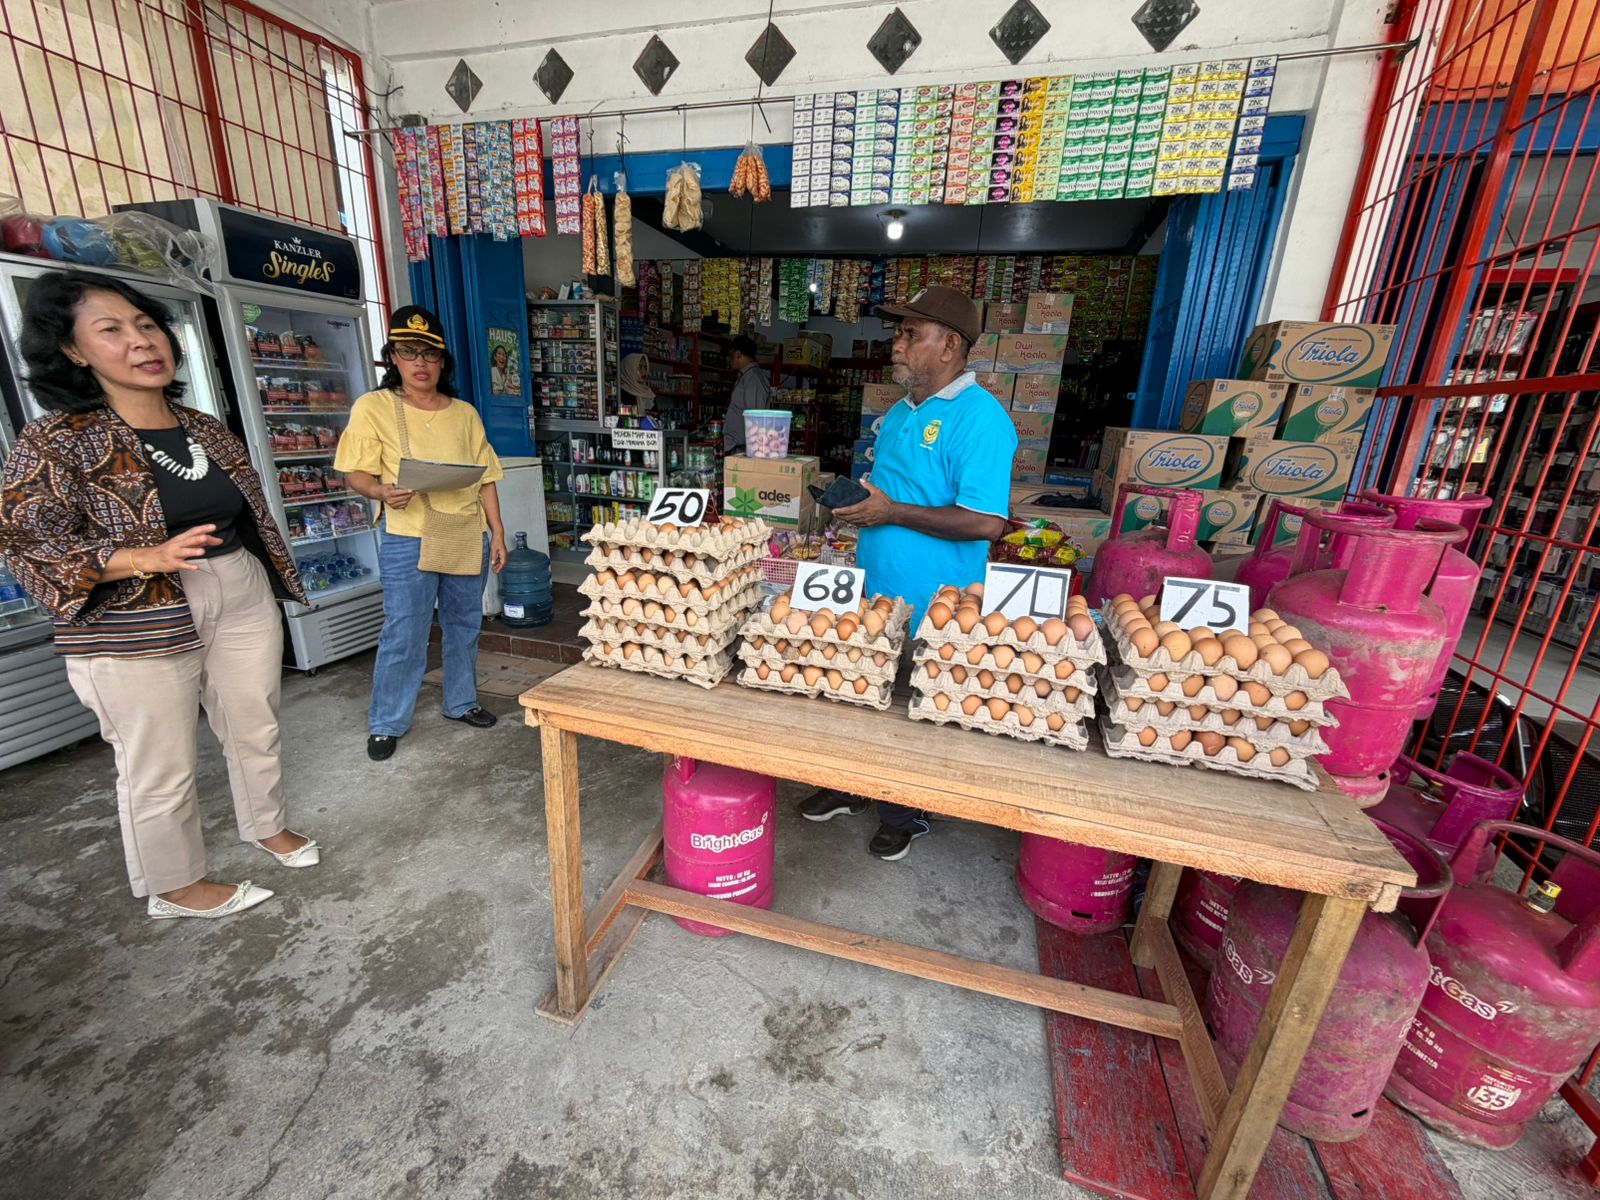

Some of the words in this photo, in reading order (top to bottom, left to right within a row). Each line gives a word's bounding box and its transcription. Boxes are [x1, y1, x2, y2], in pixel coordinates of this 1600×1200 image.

[1227, 62, 1242, 70] ZINC
[1255, 57, 1272, 66] ZINC
[1121, 68, 1142, 76] PANTENE
[1177, 66, 1193, 75] ZINC
[1205, 63, 1220, 72] ZINC
[1201, 82, 1216, 91] ZINC
[1222, 82, 1238, 90] ZINC
[1251, 78, 1268, 87] ZINC
[1118, 87, 1139, 95] PANTENE
[1174, 86, 1190, 94] ZINC
[1197, 102, 1212, 110] ZINC
[1218, 102, 1234, 110] ZINC
[1248, 98, 1264, 106] ZINC
[1115, 106, 1136, 114] PANTENE
[1142, 104, 1163, 112] PANTENE
[1171, 105, 1187, 113] ZINC
[1138, 122, 1160, 130] PANTENE
[1193, 122, 1208, 131] ZINC
[1214, 122, 1230, 130] ZINC
[1245, 118, 1260, 126] ZINC
[1168, 125, 1183, 133] ZINC
[1164, 144, 1180, 152] ZINC
[1189, 141, 1204, 149] ZINC
[1209, 141, 1224, 149] ZINC
[1161, 162, 1176, 170] ZINC
[1186, 160, 1200, 168] ZINC
[1205, 160, 1221, 168] ZINC
[1182, 179, 1197, 187] ZINC
[1202, 178, 1217, 186] ZINC
[273, 240, 322, 259] KANZLER
[262, 251, 336, 285] Singles
[1041, 309, 1062, 319] Koala
[489, 328, 517, 345] HAUS?
[1015, 341, 1033, 350] Dwi
[1019, 350, 1047, 361] Koala
[1299, 341, 1360, 364] Triola
[1028, 389, 1050, 398] Koala
[1236, 401, 1258, 411] Triola
[1320, 405, 1342, 417] Triola
[1016, 427, 1035, 436] oala
[1148, 449, 1202, 470] Triola
[1266, 458, 1325, 479] Triola
[758, 489, 791, 503] ades
[650, 490, 702, 524] 50
[803, 568, 856, 605] 68
[990, 565, 1068, 619] 70
[1166, 579, 1241, 628] 75
[691, 833, 740, 853] Bright
[740, 825, 764, 845] Gas
[1225, 938, 1253, 984] Gas
[1441, 976, 1498, 1020] Gas
[1470, 1087, 1509, 1107] 135
